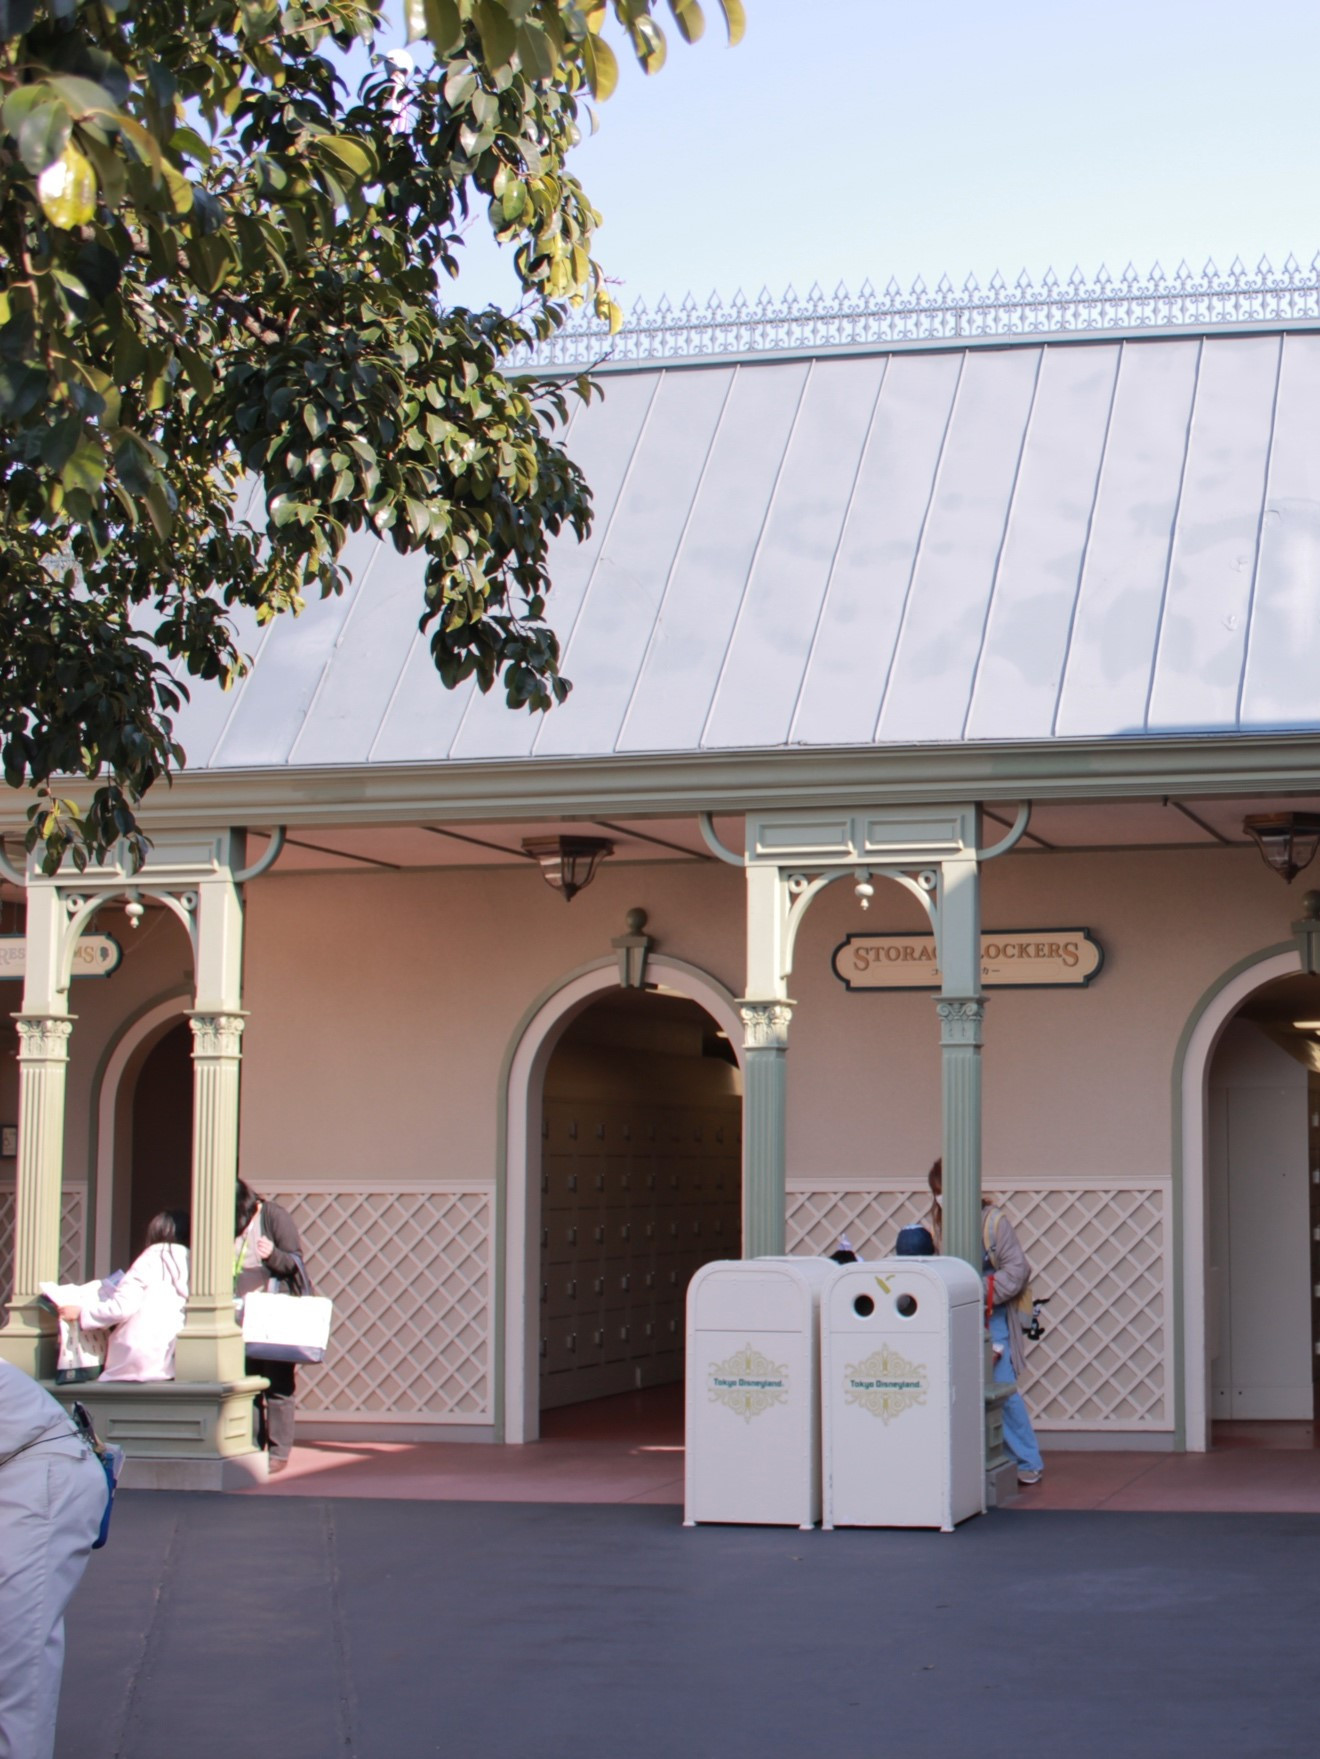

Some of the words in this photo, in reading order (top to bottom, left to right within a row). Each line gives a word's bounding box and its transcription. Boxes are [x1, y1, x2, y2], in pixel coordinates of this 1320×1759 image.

[853, 945, 937, 972] STORA
[980, 941, 1080, 968] OCKERS
[713, 1377, 737, 1388] Tokyo
[850, 1379, 874, 1390] Tokyo
